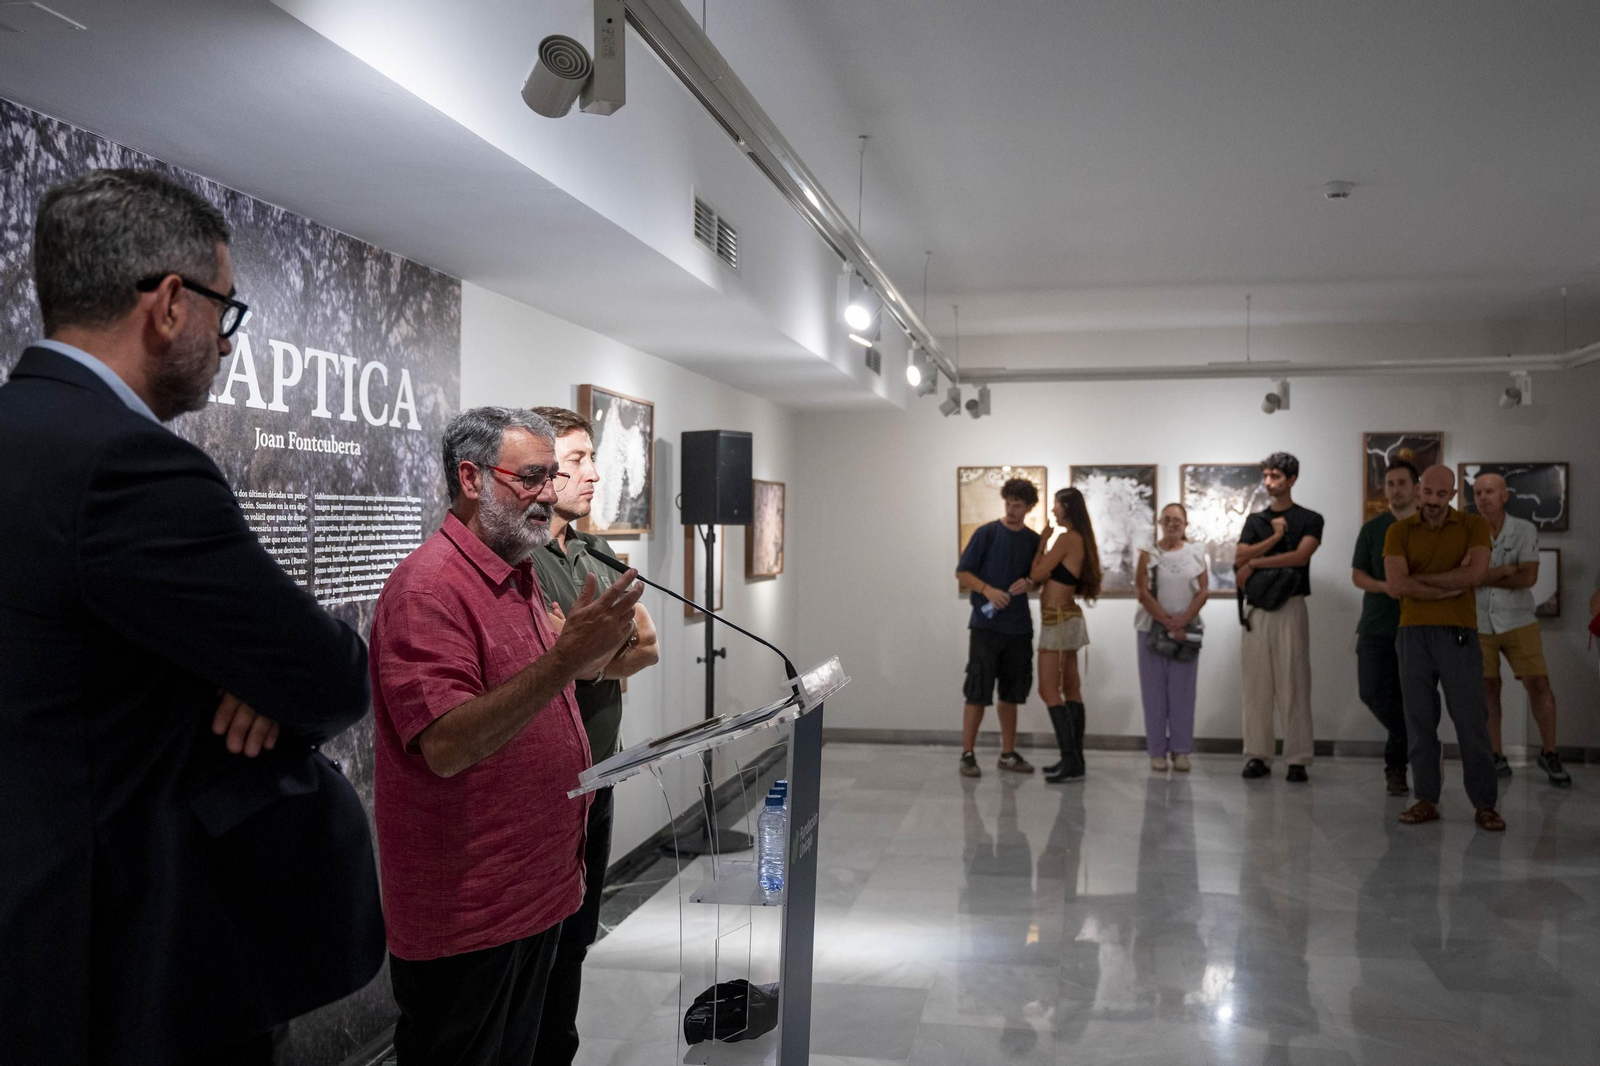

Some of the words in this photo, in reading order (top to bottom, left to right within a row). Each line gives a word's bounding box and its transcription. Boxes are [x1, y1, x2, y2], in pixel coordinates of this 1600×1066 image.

[207, 310, 422, 431] ÁPTICA
[254, 427, 286, 450] Joan
[288, 431, 361, 456] Fontcuberta
[238, 489, 248, 497] dos
[248, 490, 267, 498] últimas
[268, 490, 286, 499] décadas
